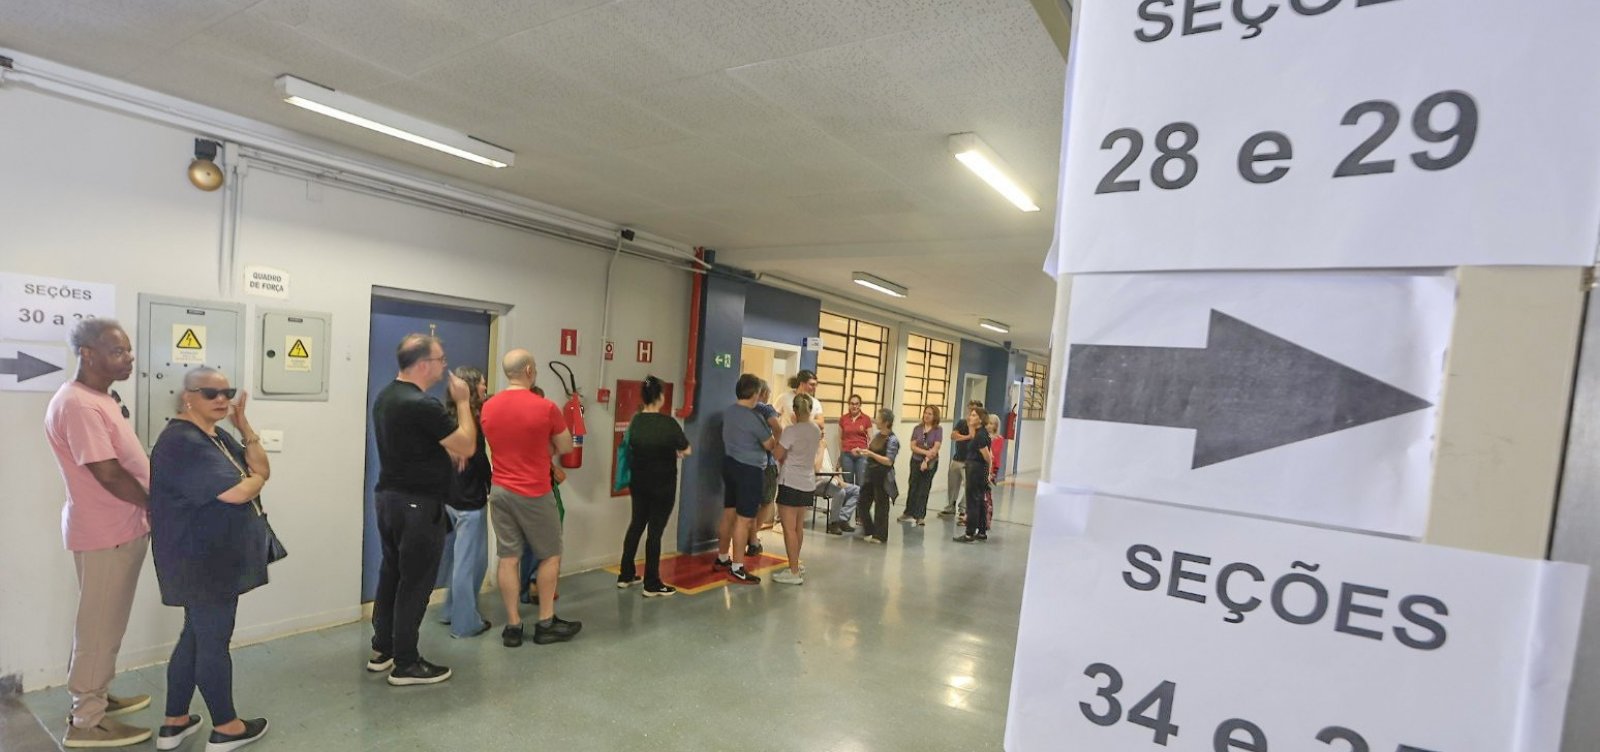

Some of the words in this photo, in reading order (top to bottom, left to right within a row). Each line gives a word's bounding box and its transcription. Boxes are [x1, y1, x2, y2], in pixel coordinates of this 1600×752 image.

[1095, 122, 1199, 194] 28
[1237, 131, 1293, 184] e
[1332, 89, 1480, 178] 29
[253, 272, 282, 282] QUADRO
[24, 283, 92, 301] SEÇÕES
[262, 282, 284, 293] FORÇA
[18, 308, 45, 324] 30
[52, 314, 65, 325] a
[639, 342, 651, 361] H
[1121, 543, 1450, 651] SEÇÕES
[1079, 662, 1180, 747] 34
[1212, 717, 1268, 752] e
